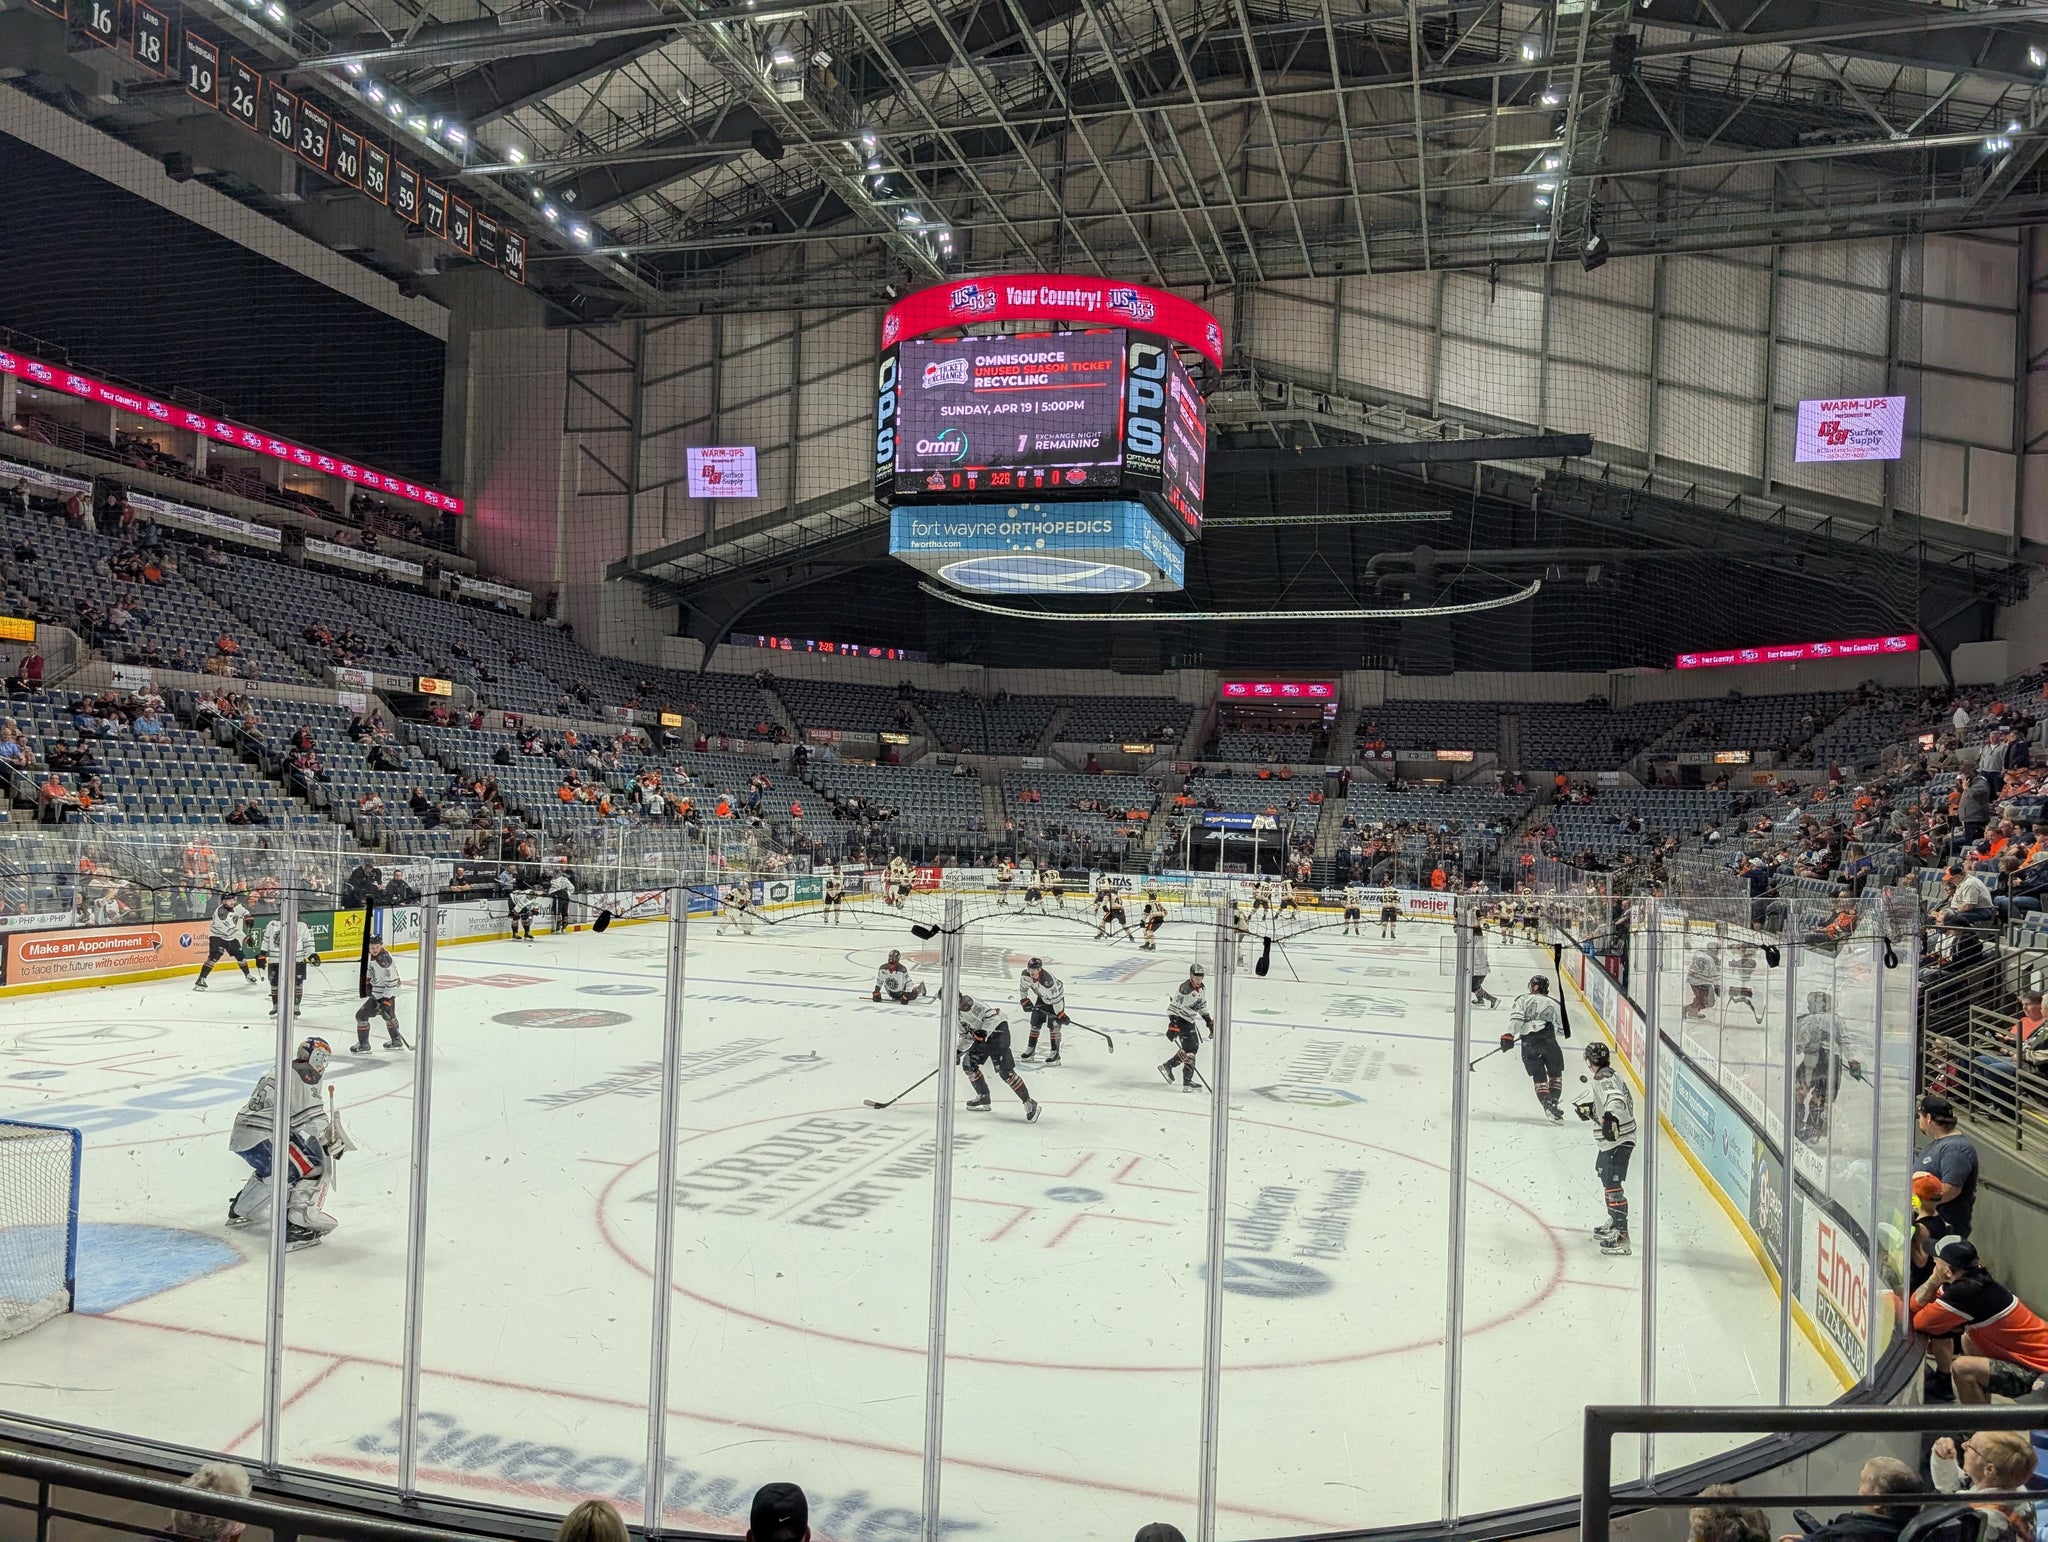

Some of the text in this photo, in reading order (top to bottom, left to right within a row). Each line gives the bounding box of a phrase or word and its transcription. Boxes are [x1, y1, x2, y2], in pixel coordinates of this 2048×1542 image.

[91, 2, 113, 34] 16
[137, 30, 160, 63] 18
[189, 64, 211, 93] 19
[231, 85, 254, 118] 26
[272, 110, 292, 139] 30
[300, 127, 324, 157] 33
[337, 151, 356, 178] 40
[367, 166, 384, 193] 58
[399, 186, 414, 210] 59
[428, 203, 443, 228] 77
[454, 221, 468, 247] 91
[505, 244, 523, 270] 504
[969, 292, 996, 310] 93.3
[1006, 286, 1102, 311] Your Country!
[1128, 301, 1155, 318] 93.3
[938, 361, 963, 373] TICKET
[975, 351, 1065, 367] OMNISOURCE
[974, 360, 1113, 377] UNUSED SEASON TICKET
[927, 371, 964, 384] EXCHANGE
[974, 374, 1048, 388] RECYCLING
[940, 404, 991, 416] SUNDAY,
[993, 403, 1018, 414] APR
[1020, 402, 1032, 413] 19
[1041, 400, 1085, 412] 5:00PM
[1820, 399, 1887, 412] WARM-UPS
[1035, 431, 1102, 441] EXCHANGE NIGHT
[1849, 428, 1884, 437] Surface
[916, 437, 961, 454] Omni
[1035, 439, 1100, 451] REMAINING
[1849, 437, 1882, 446] Supply
[700, 448, 745, 458] WARM-UPS
[1126, 453, 1161, 465] OPTIMUM
[952, 474, 960, 488] 0
[968, 479, 976, 490] 0
[990, 472, 1011, 487] 2:26
[1051, 470, 1060, 485] 0
[911, 520, 1112, 540] fort wayne ORTHOPEDICS
[910, 540, 962, 550] fwortho.com
[770, 636, 777, 648] 0
[818, 641, 835, 653] 2:26
[887, 648, 894, 660] 0
[795, 885, 810, 894] Great
[1410, 893, 1448, 913] meijer
[18, 916, 36, 925] PHP
[50, 914, 66, 922] PHP
[29, 936, 143, 956] Make an Appointment
[21, 966, 30, 976] to
[32, 964, 51, 975] face
[53, 962, 68, 973] the
[68, 960, 94, 973] future
[95, 957, 112, 969] with
[626, 1116, 877, 1212] PURDUE
[713, 1123, 912, 1218] UNIVERSITY
[793, 1179, 906, 1230] FORT
[1817, 1219, 1868, 1341] Elmo's
[1817, 1294, 1841, 1341] PIZZA
[1846, 1331, 1866, 1377] SUBS
